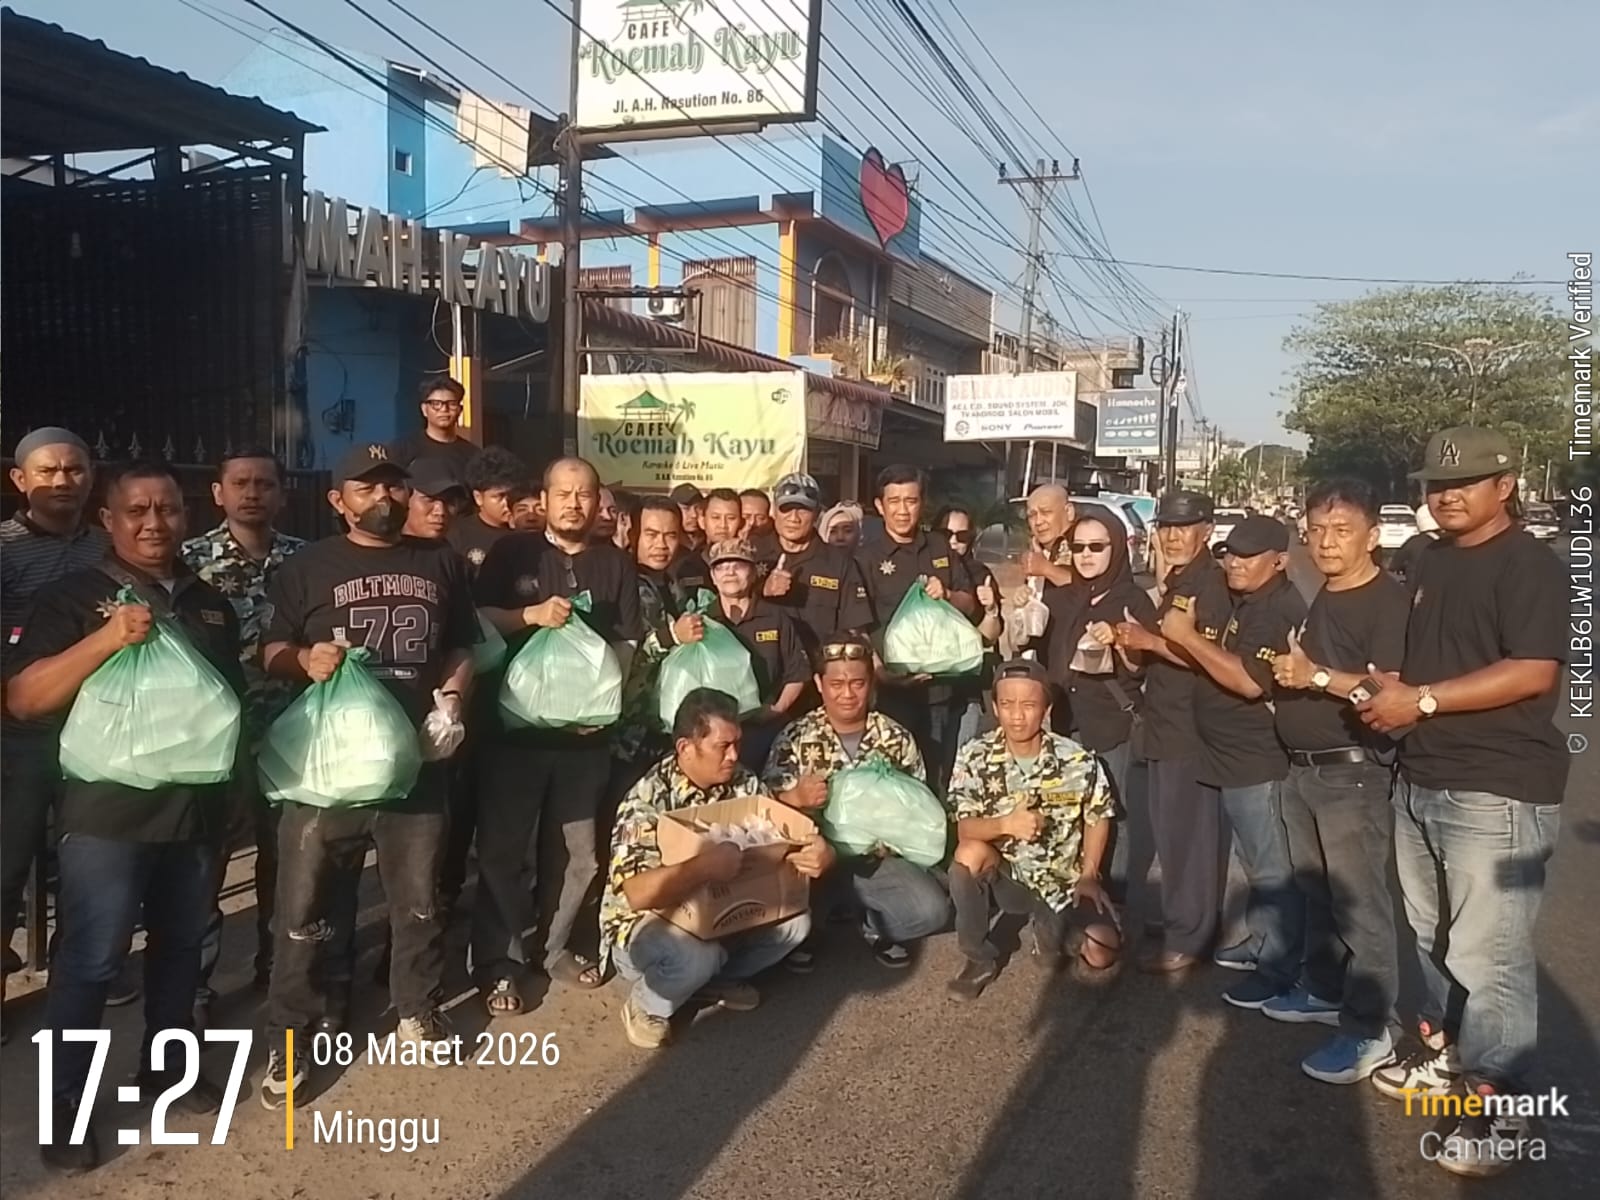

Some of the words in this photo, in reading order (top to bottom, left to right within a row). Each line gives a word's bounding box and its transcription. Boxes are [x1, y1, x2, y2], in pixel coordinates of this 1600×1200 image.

[628, 20, 670, 40] CAFE
[579, 29, 704, 84] Roemah
[714, 22, 801, 74] Kayu
[632, 98, 657, 112] A.H.
[661, 94, 717, 110] Nasution
[721, 91, 742, 105] No.
[439, 229, 550, 323] KAYU
[625, 422, 664, 437] CAFE
[592, 431, 695, 460] Roemah
[703, 431, 776, 462] Kayu
[682, 460, 699, 470] Live
[334, 574, 439, 608] BILTMORE
[350, 604, 428, 663] 72
